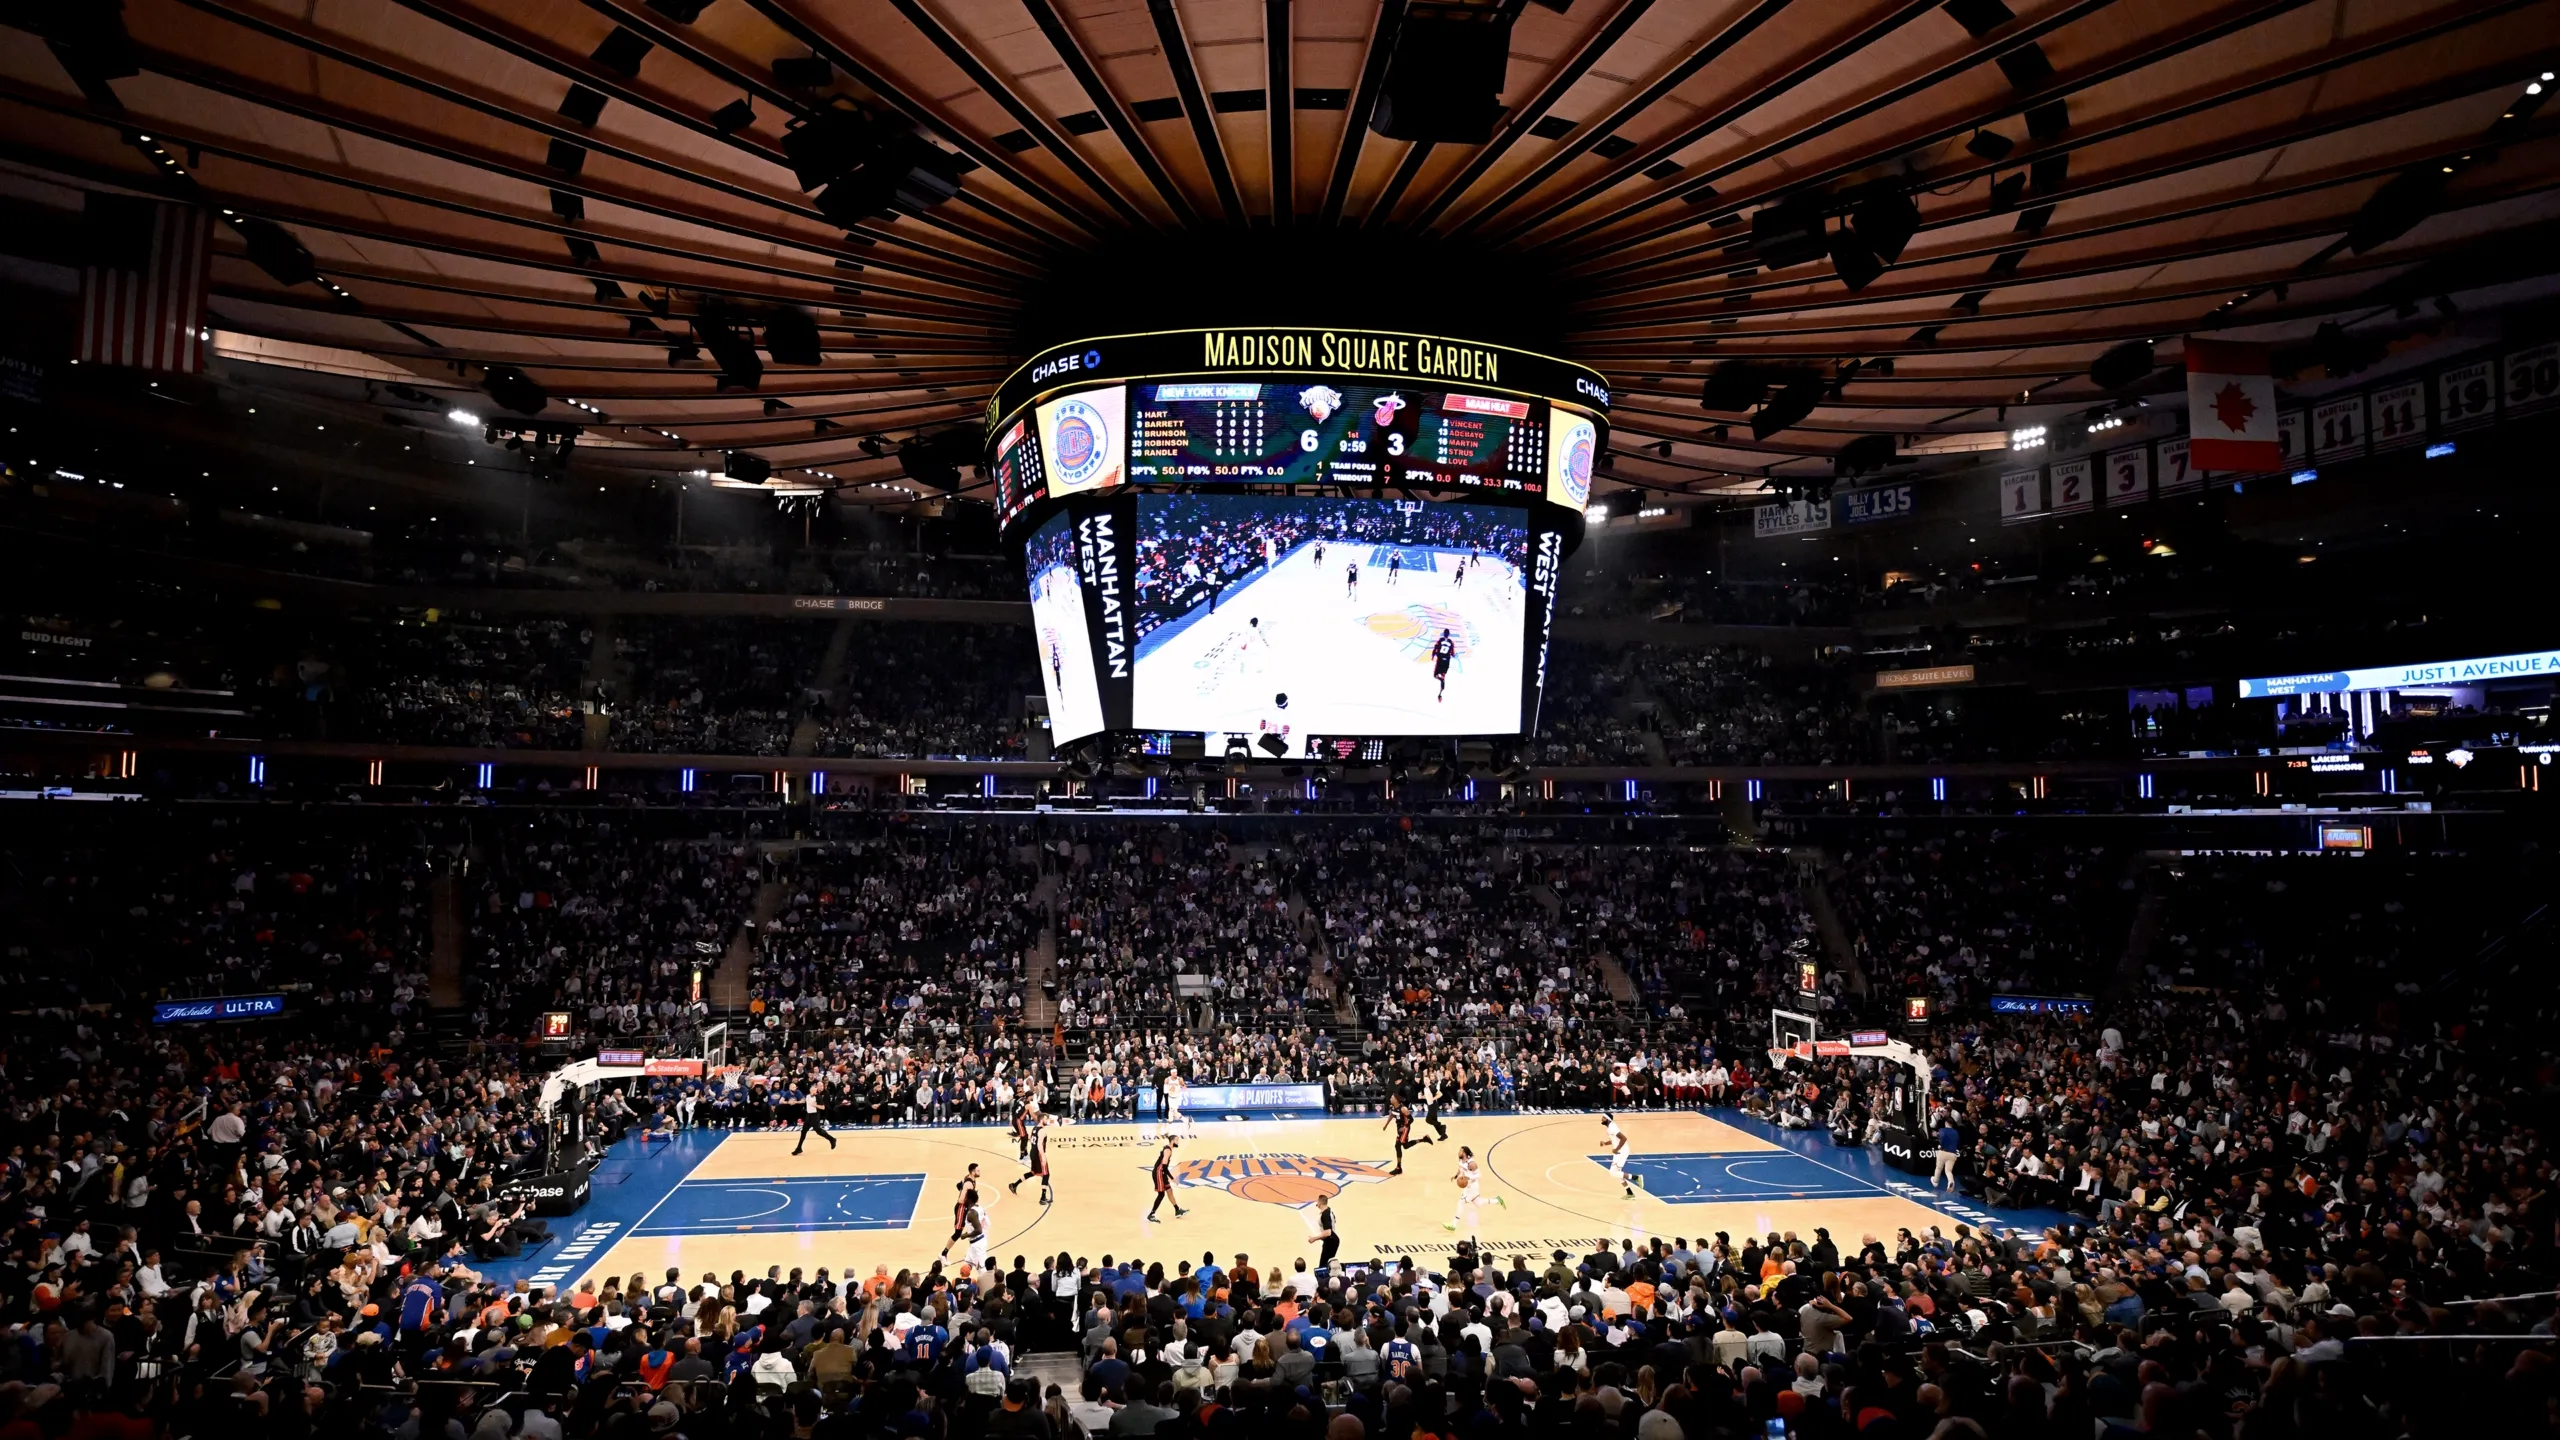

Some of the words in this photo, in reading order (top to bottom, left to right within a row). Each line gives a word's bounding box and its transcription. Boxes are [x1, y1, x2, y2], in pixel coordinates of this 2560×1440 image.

[1204, 332, 1312, 367] MADISON
[1321, 332, 1409, 372] SQUARE
[1417, 338, 1498, 383] GARDEN
[1032, 354, 1080, 383] CHASE
[1162, 387, 1185, 398] NEW
[1187, 387, 1214, 397] YORK
[1216, 386, 1255, 397] KNICKS
[1576, 378, 1609, 407] CHASE
[2447, 378, 2488, 420] 19
[1465, 399, 1491, 410] MIAMI
[1491, 402, 1511, 413] HEAT
[1137, 411, 1143, 419] 3
[1144, 411, 1168, 419] HART
[1216, 410, 1223, 418] 0
[1230, 410, 1235, 418] 1
[1244, 410, 1249, 418] 1
[1257, 410, 1264, 418] 0
[2382, 400, 2416, 438] 11
[1136, 420, 1142, 428] 9
[1144, 420, 1184, 428] BARRETT
[1216, 419, 1223, 428] 0
[1229, 419, 1236, 428] 0
[1243, 419, 1250, 428] 0
[1257, 419, 1264, 428] 3
[1442, 419, 1449, 427] 2
[1449, 420, 1484, 430] VINCENT
[1144, 430, 1186, 438] BRUNSON
[1216, 429, 1223, 438] 0
[1229, 429, 1236, 438] 0
[1243, 429, 1250, 438] 0
[1257, 429, 1264, 438] 3
[1348, 431, 1359, 439] 1st
[1438, 428, 1448, 436] 13
[1449, 430, 1485, 439] ADEBAYO
[2322, 414, 2354, 449] 11
[1132, 440, 1142, 448] 23
[1144, 439, 1189, 447] ROBINSON
[1217, 439, 1222, 447] 1
[1229, 439, 1236, 447] 0
[1243, 439, 1250, 447] 0
[1257, 439, 1264, 447] 0
[1301, 430, 1319, 452] 6
[1339, 441, 1367, 453] 9:59
[1387, 433, 1405, 456] 3
[1438, 437, 1448, 446] 16
[1449, 439, 1479, 449] MARTIN
[1131, 449, 1142, 457] 30
[1144, 449, 1178, 457] RANDLE
[1216, 448, 1223, 456] 0
[1230, 448, 1235, 456] 1
[1244, 448, 1249, 456] 1
[1257, 448, 1264, 456] 0
[1438, 447, 1448, 455] 31
[1448, 448, 1474, 457] STRUS
[1054, 450, 1101, 479] PLAYOFFS
[1317, 462, 1323, 470] 1
[1330, 463, 1351, 471] TEAM
[1352, 463, 1376, 471] FOULS
[1384, 464, 1391, 473] 0
[1437, 456, 1448, 465] 42
[1448, 458, 1468, 467] LOVE
[2170, 452, 2189, 482] 7
[1131, 467, 1157, 476] 3PT%
[1162, 466, 1185, 476] 50.0
[1187, 466, 1210, 476] FG%
[1215, 466, 1238, 476] 50.0
[1241, 466, 1263, 476] FT%
[1267, 467, 1284, 476] 0.0
[1333, 473, 1373, 482] TIMEOUTS
[1384, 476, 1390, 484] 7
[2118, 464, 2136, 492] 3
[1405, 470, 1434, 482] 3PT%
[1436, 473, 1451, 483] 0.0
[1459, 475, 1481, 486] FG%
[1483, 477, 1502, 488] 33.3
[1503, 479, 1522, 490] FT%
[1523, 482, 1542, 493] 100.0
[2062, 475, 2080, 503] 2
[1848, 491, 1870, 507] BILLY
[1872, 486, 1912, 515] 135
[2015, 485, 2026, 512] 1
[1760, 503, 1796, 519] HARRY
[1804, 500, 1828, 523] 15
[1849, 503, 1869, 516] JOEL
[1758, 514, 1800, 530] STYLES
[1078, 517, 1097, 587] WEST
[1533, 531, 1554, 597] WEST
[1094, 514, 1128, 678] MANHATTAN
[794, 599, 835, 608] CHASE
[848, 600, 883, 610] BRIDGE
[21, 631, 52, 643] BUD
[52, 634, 93, 648] LIGHT
[1912, 672, 1939, 681] SUITE
[1942, 669, 1970, 679] LEVEL
[2402, 666, 2446, 682] JUST
[2450, 666, 2457, 678] 1
[2463, 658, 2542, 677] AVENUE
[2266, 674, 2334, 687] MANHATTAN
[2267, 685, 2295, 694] WEST
[2287, 760, 2308, 769] 7:38
[2311, 755, 2350, 764] LAKERS
[2539, 753, 2552, 765] 0
[2311, 763, 2364, 772] WARRIORS
[1802, 973, 1816, 989] 21
[162, 1005, 213, 1019] Michelob
[226, 1000, 276, 1013] ULTRA
[1912, 1007, 1924, 1017] 21
[550, 1024, 564, 1034] 21
[1245, 1090, 1283, 1105] PLAYOFFS
[1216, 1153, 1254, 1161] NEW
[1174, 1156, 1396, 1181] KNICKS
[1885, 1181, 1938, 1197] NEW
[1932, 1200, 2004, 1223] YORK
[553, 1221, 621, 1260] KNICKS
[917, 1343, 930, 1359] 11
[1391, 1352, 1409, 1360] RANDLE
[1391, 1360, 1411, 1378] 30
